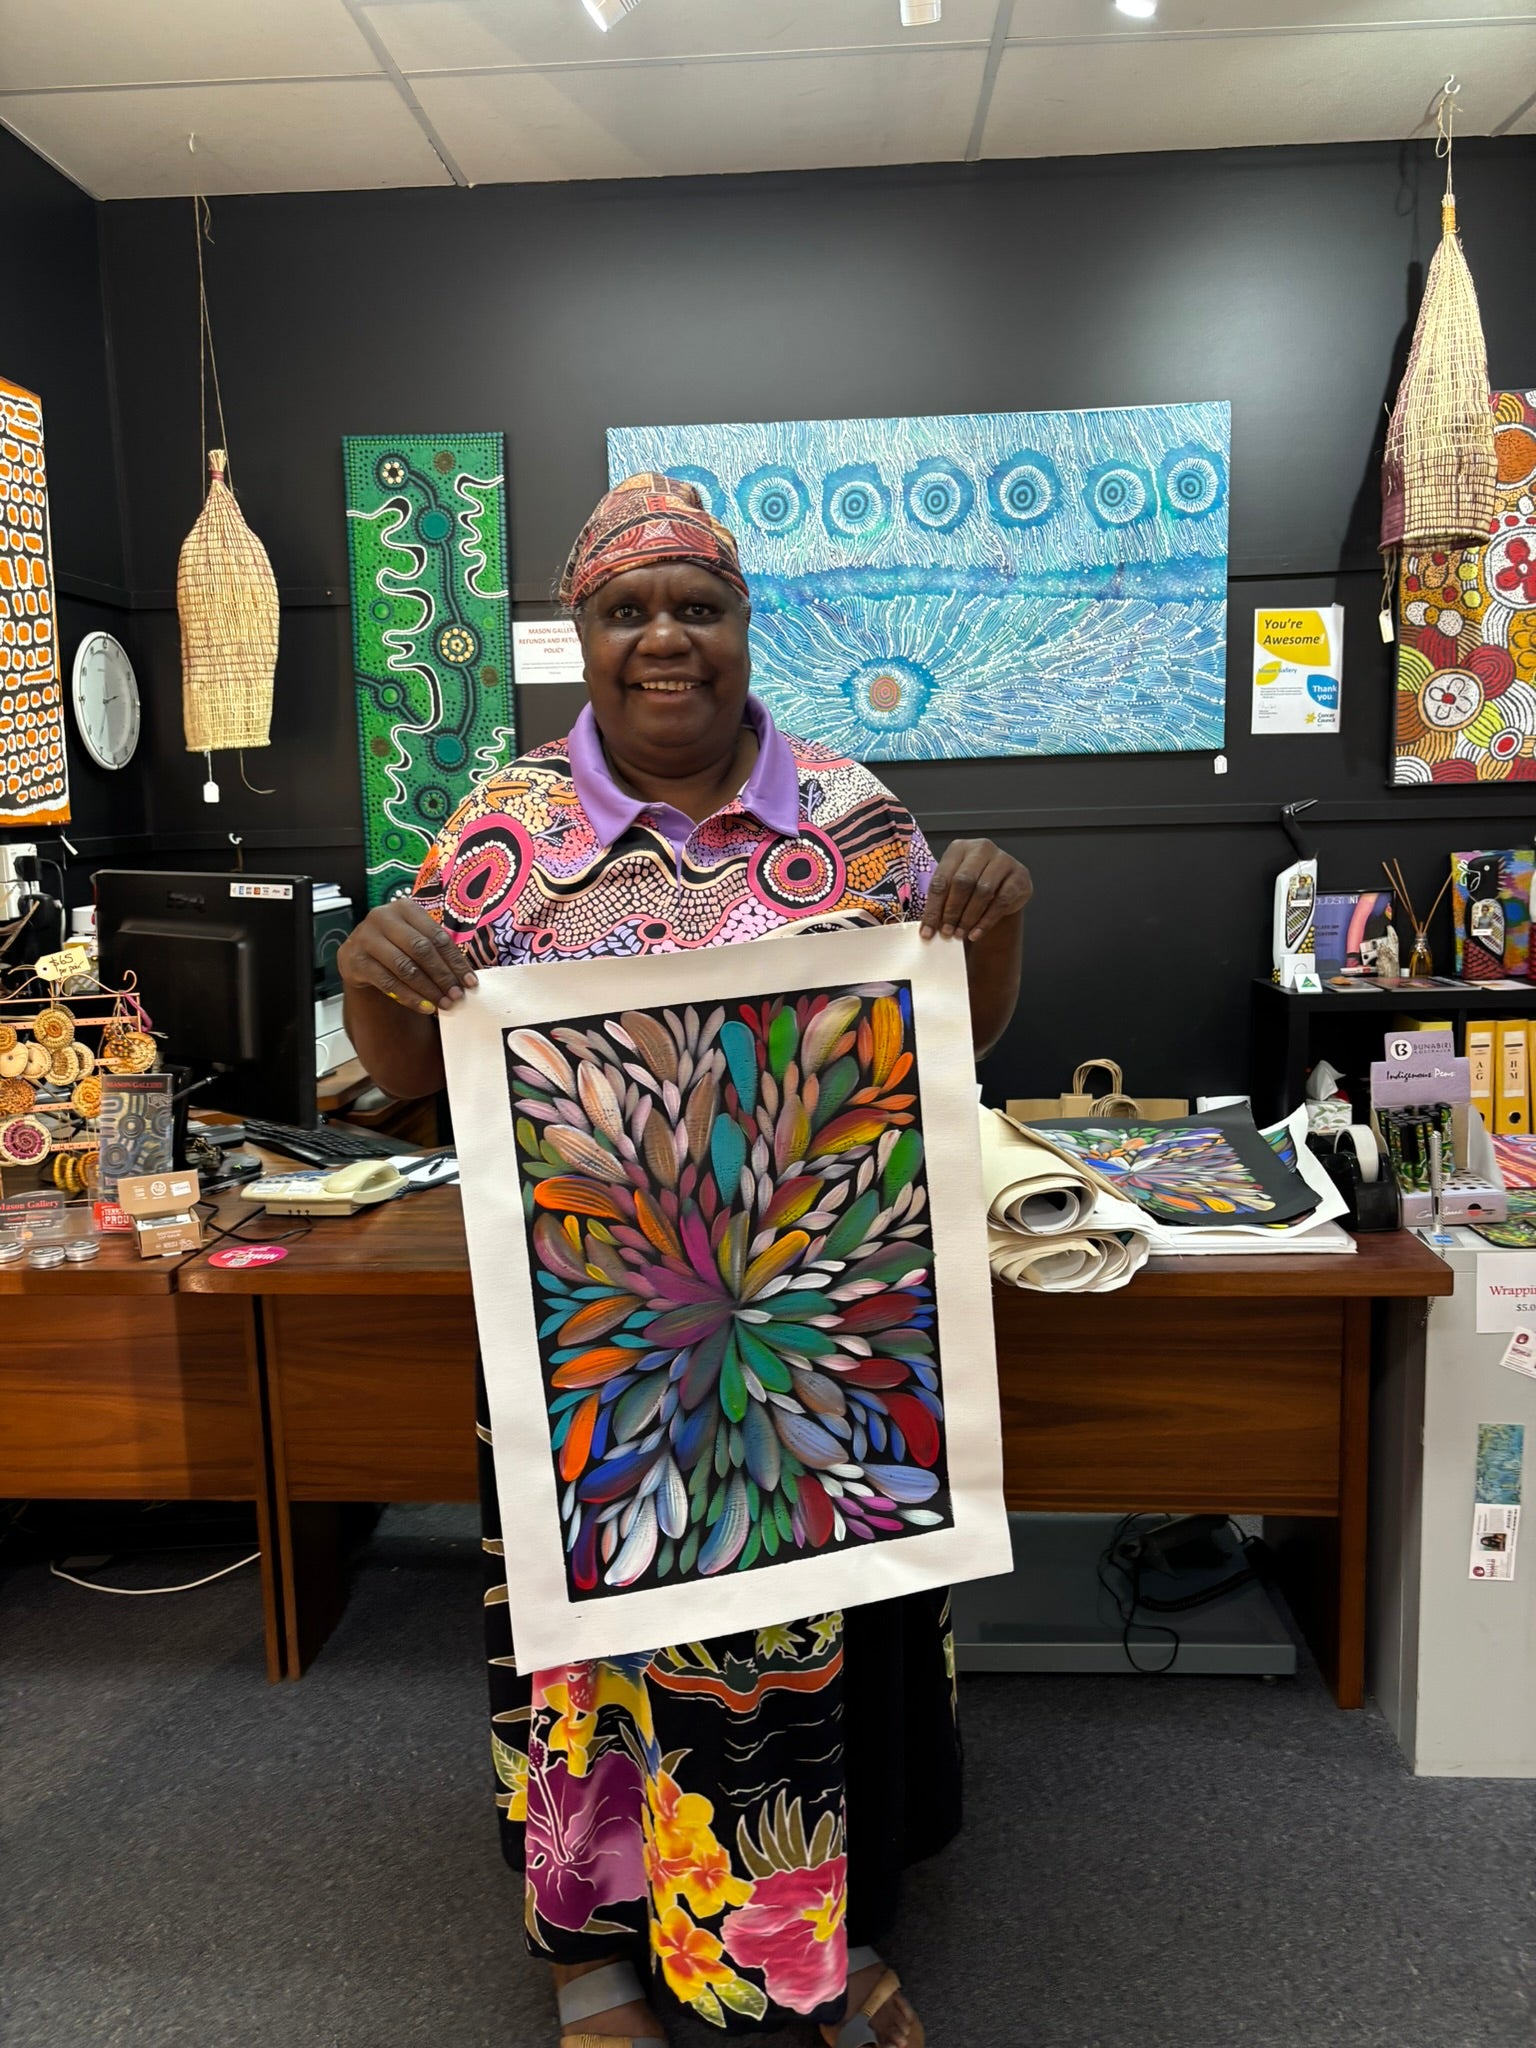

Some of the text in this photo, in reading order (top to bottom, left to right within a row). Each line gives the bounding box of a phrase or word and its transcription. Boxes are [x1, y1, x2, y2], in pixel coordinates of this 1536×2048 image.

[1264, 618, 1303, 629] You're
[1263, 633, 1325, 645] Awesome!
[1312, 684, 1337, 692] Thank
[49, 953, 74, 971] $65
[1476, 1061, 1484, 1069] A
[1386, 1067, 1455, 1082] Indigenous Pens
[1475, 1072, 1484, 1080] G
[27, 1200, 59, 1210] Gallery
[105, 1215, 130, 1225] PROU
[1489, 1285, 1536, 1298] Wrappi
[1516, 1303, 1536, 1312] $5.0
